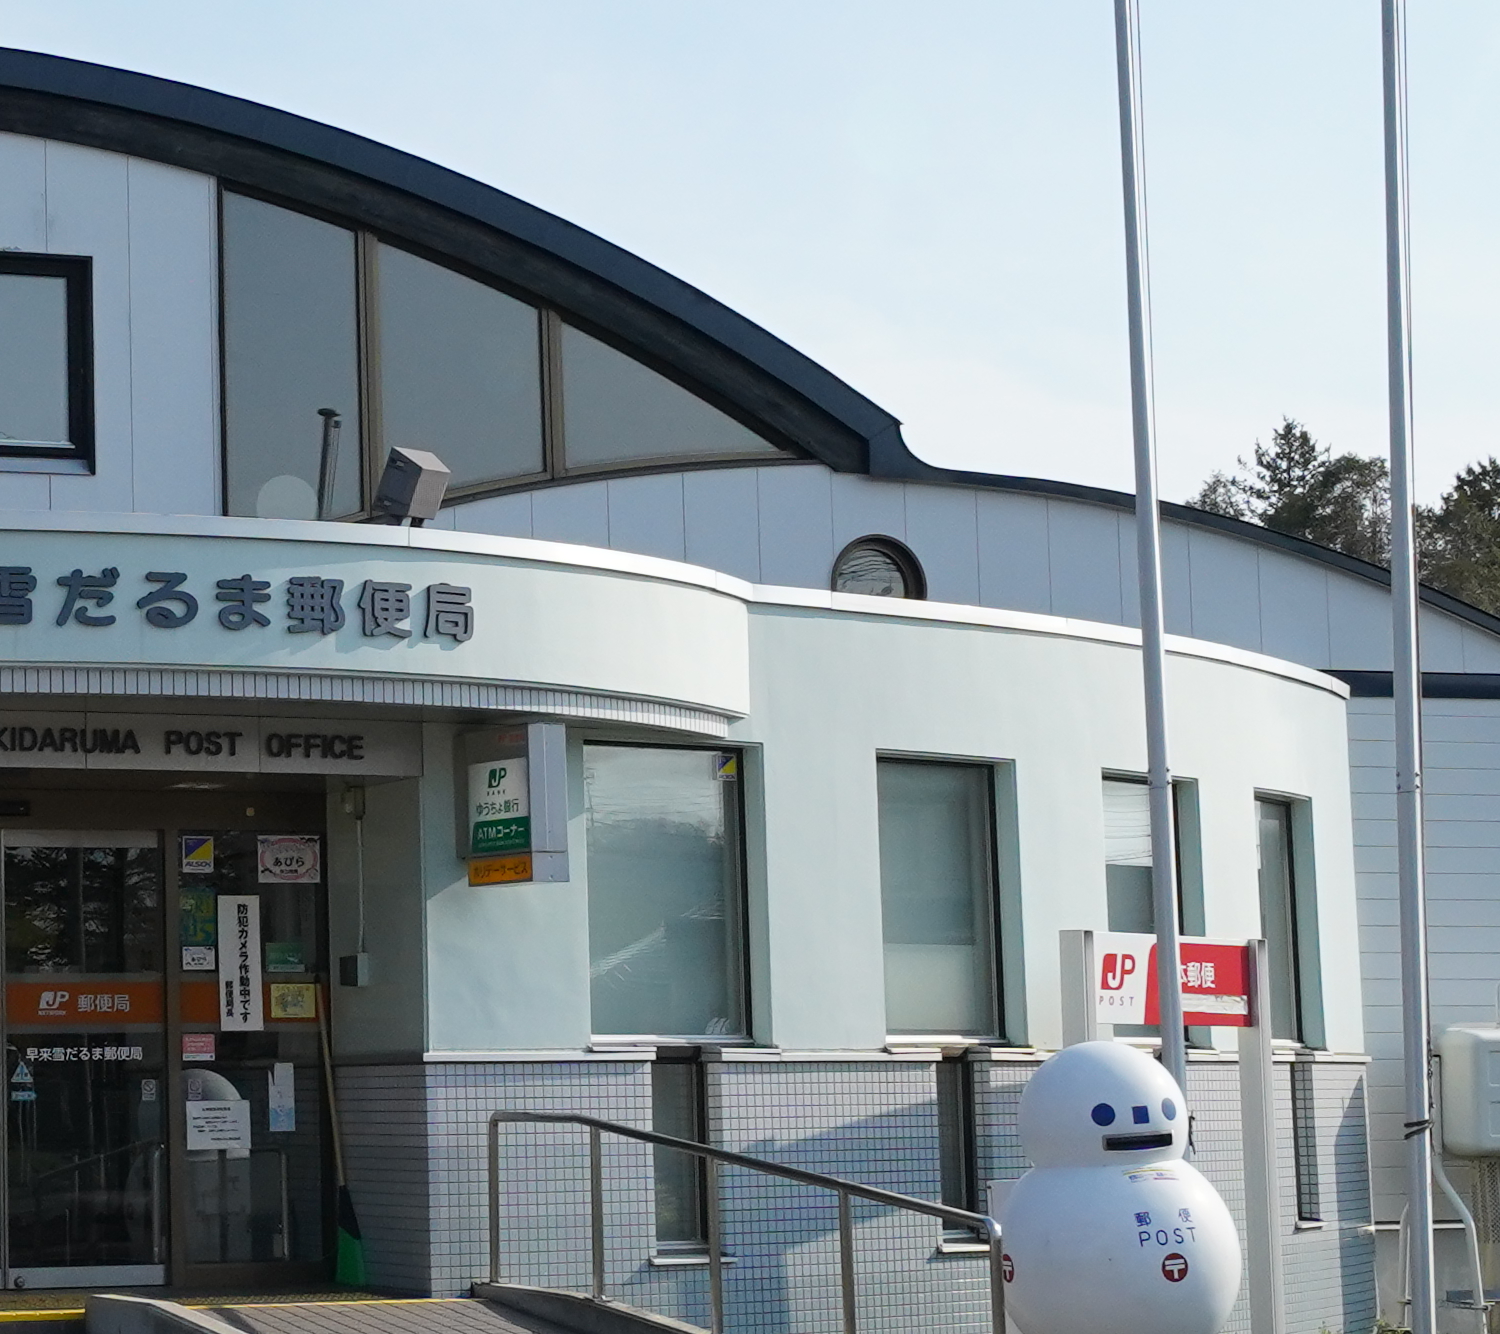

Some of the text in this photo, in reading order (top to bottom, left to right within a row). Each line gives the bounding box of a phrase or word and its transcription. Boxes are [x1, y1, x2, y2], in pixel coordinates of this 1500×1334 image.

[164, 730, 243, 757] POST
[265, 734, 365, 761] OFFICE
[475, 797, 520, 817] ゆうちょ銀行
[477, 824, 525, 840] ATMコーナー
[273, 856, 306, 868] あびら
[236, 903, 251, 1024] 防犯カメラ作動中です
[77, 993, 130, 1013] 郵便局
[1098, 995, 1135, 1007] POST
[26, 1046, 143, 1062] 早来雪だるま郵便局
[1138, 1226, 1197, 1248] POST
